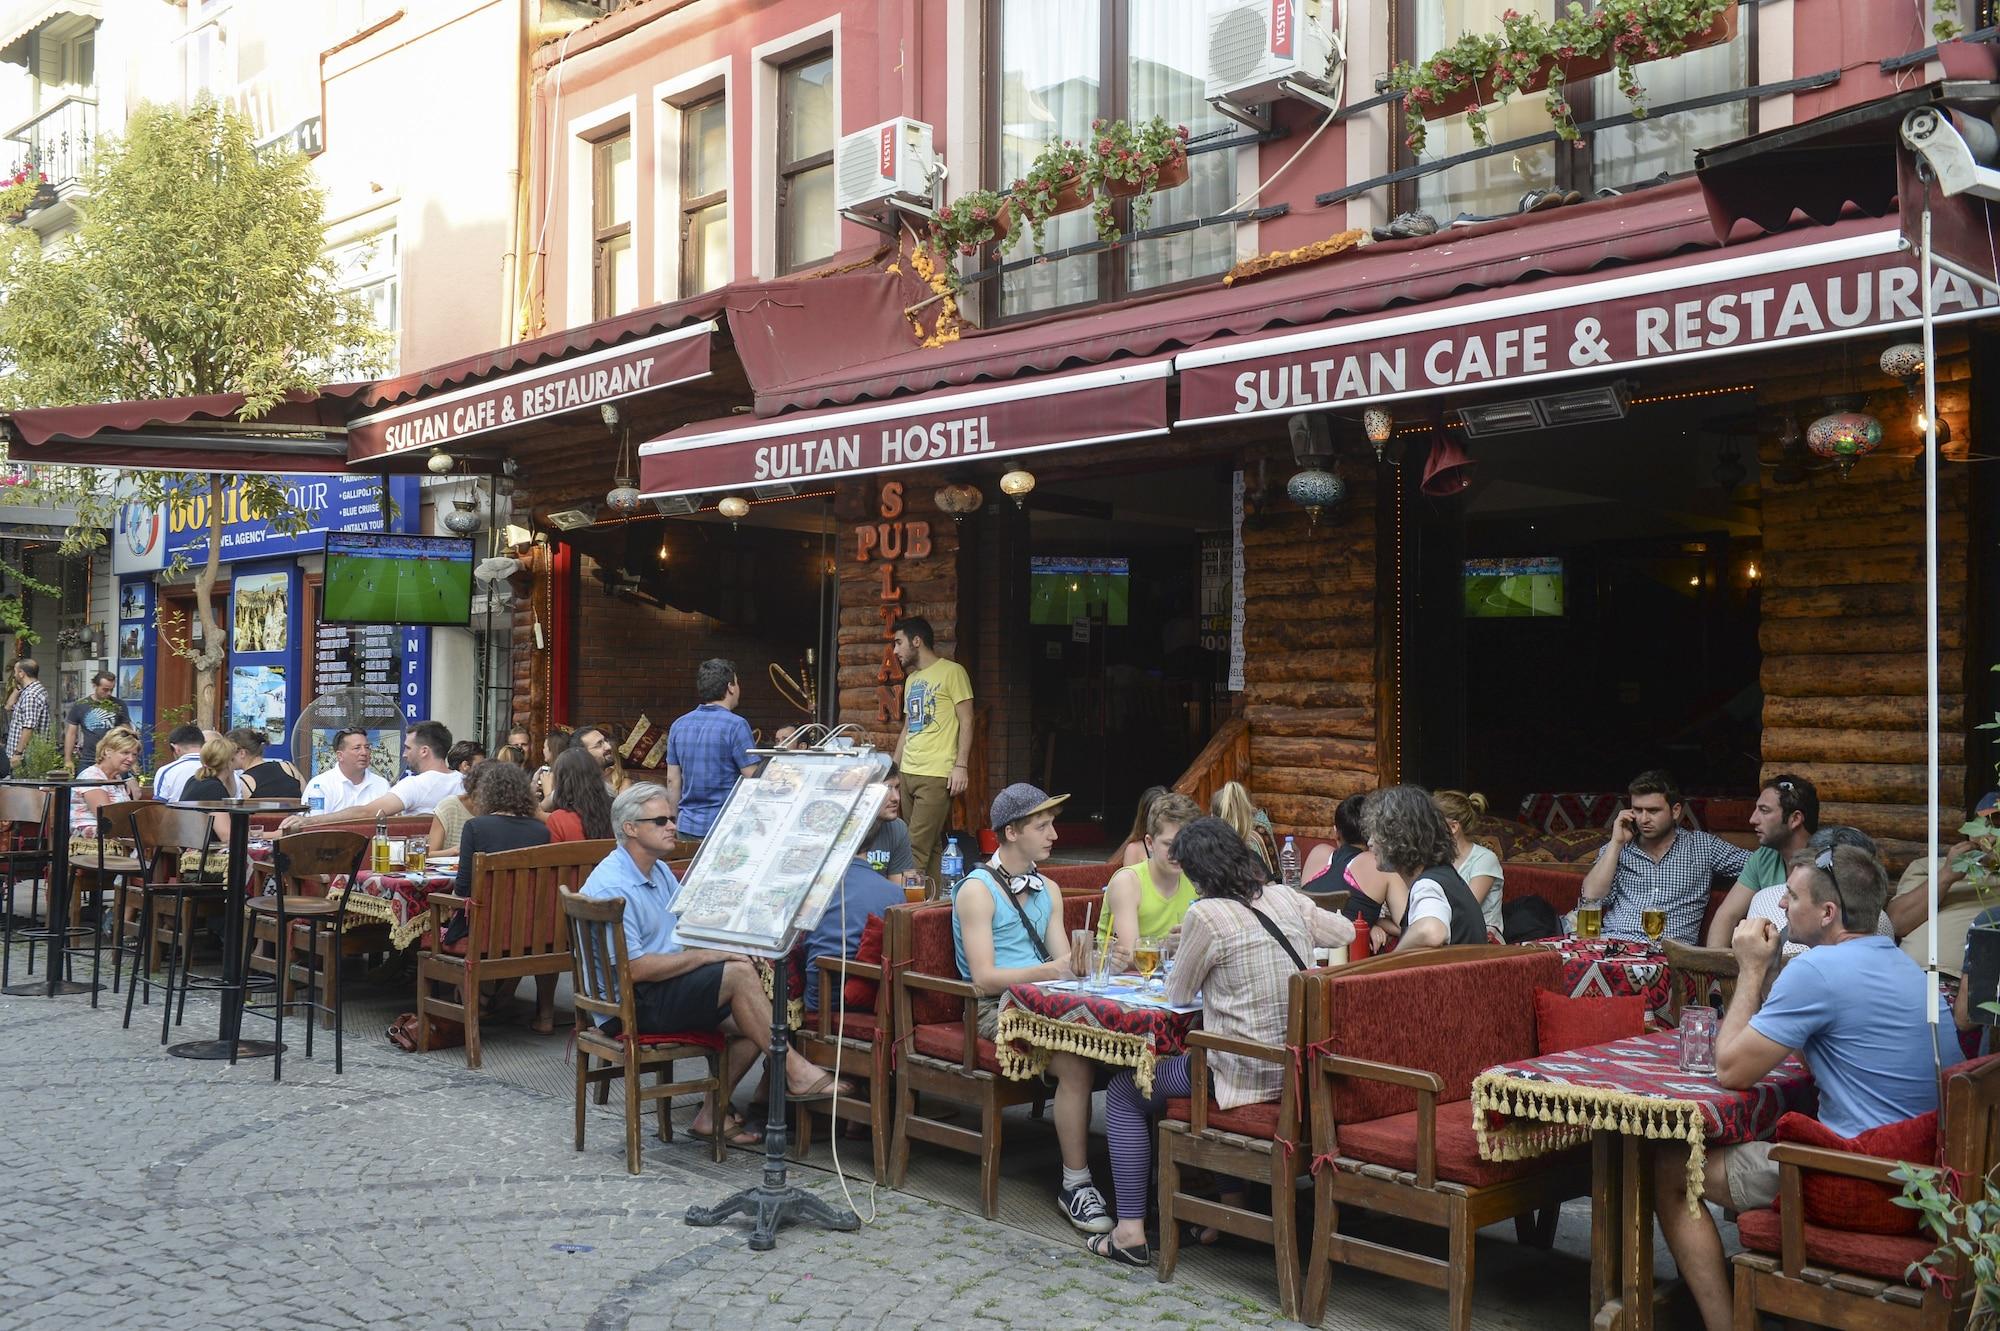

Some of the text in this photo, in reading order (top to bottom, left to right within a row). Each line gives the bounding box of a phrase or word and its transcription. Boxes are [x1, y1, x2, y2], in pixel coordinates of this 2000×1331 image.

[1234, 266, 2000, 413] SULTAN CAFE & RESTAURA
[385, 358, 655, 452] SULTAN CAFE & RESTAURANT
[754, 416, 996, 480] SULTAN HOSTEL
[342, 488, 372, 500] GALLIPOLI
[342, 503, 380, 517] BLUE CRUISE
[235, 529, 266, 545] AGENCY
[343, 521, 369, 532] ANTALYA
[855, 521, 932, 562] PUB
